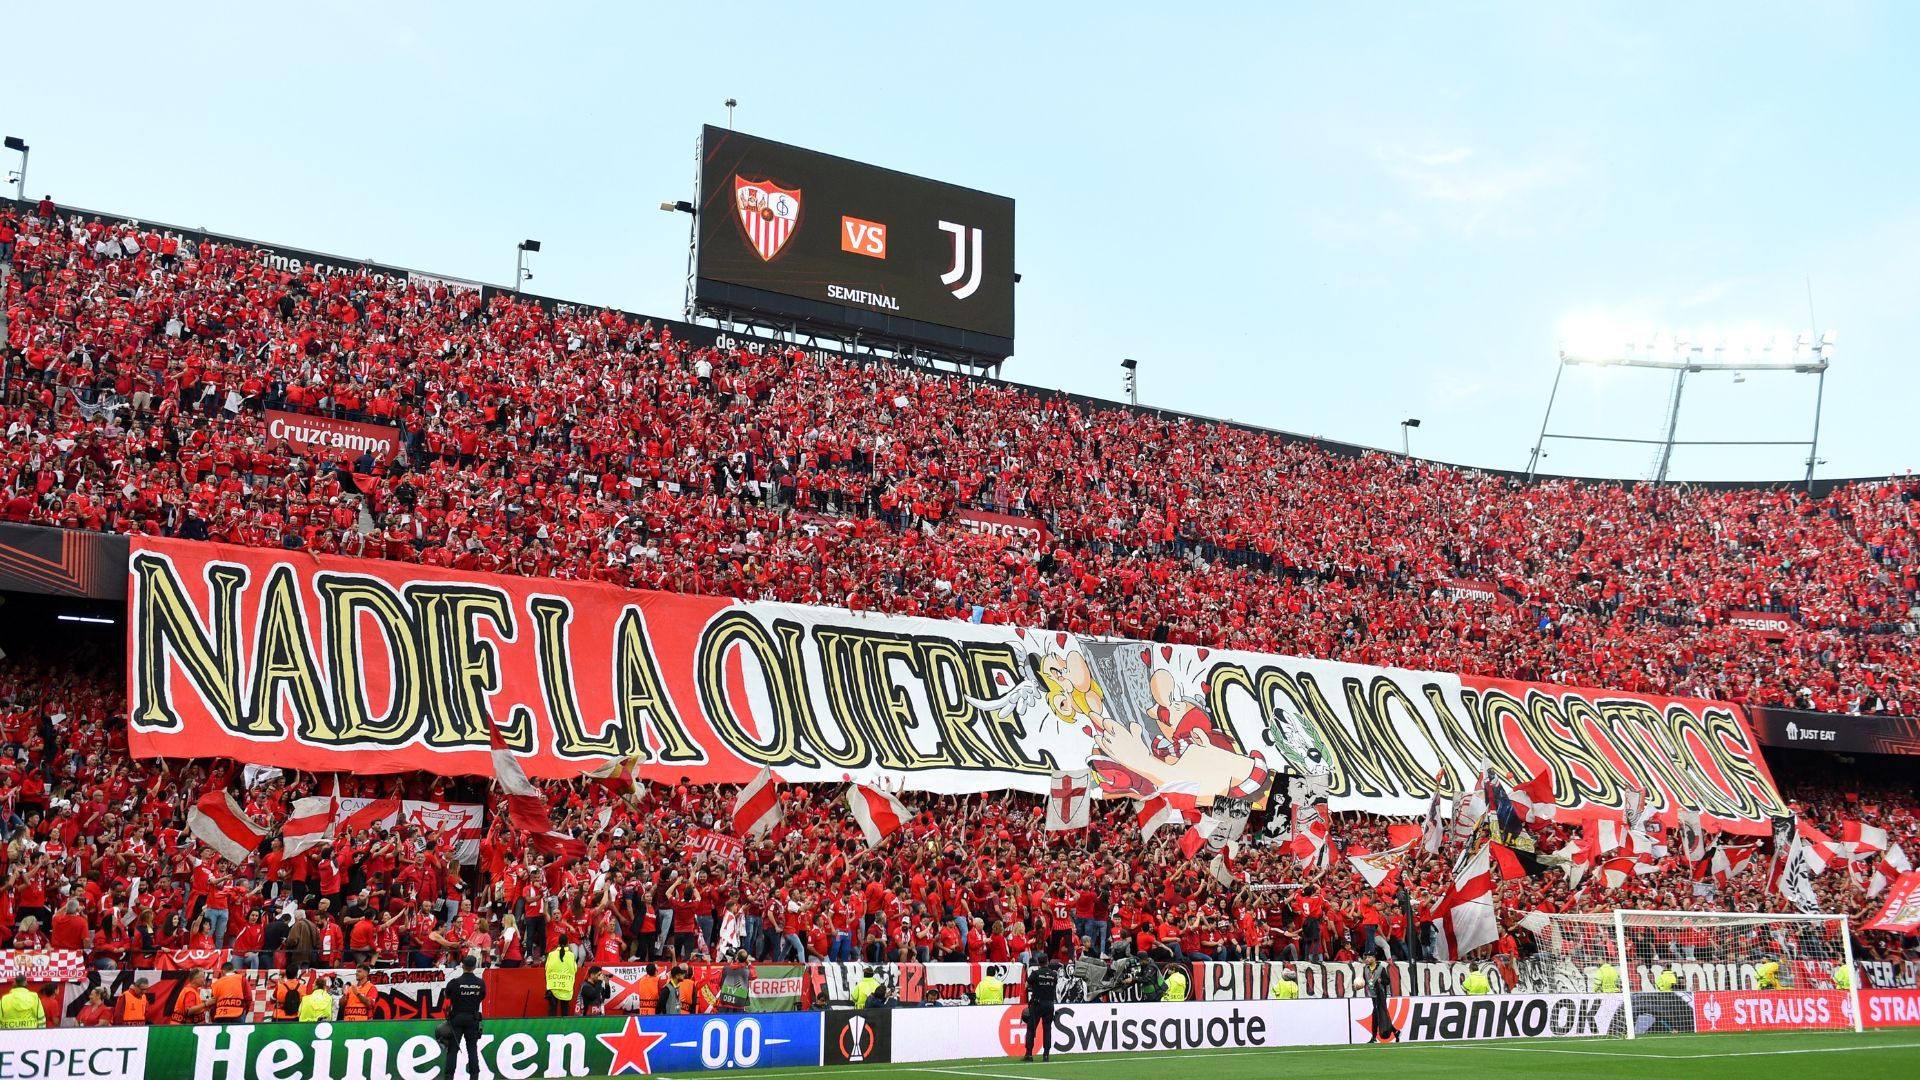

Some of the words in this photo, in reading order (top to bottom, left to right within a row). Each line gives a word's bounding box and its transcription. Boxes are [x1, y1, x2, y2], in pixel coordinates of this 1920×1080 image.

[845, 221, 884, 254] VS
[827, 284, 900, 311] SEMIFINAL
[715, 333, 735, 351] de
[270, 418, 391, 455] Cruzcampo
[980, 521, 1041, 542] DEGRO
[1738, 618, 1788, 632] DEGIRO
[133, 553, 534, 753] NADIE
[531, 597, 704, 763] LA
[1208, 664, 1464, 800] COMO
[1423, 684, 1793, 822] NOSOTROS
[1799, 728, 1819, 740] JUST
[1820, 730, 1837, 741] EAT
[1054, 906, 1068, 919] 16
[1302, 902, 1310, 915] 9
[391, 970, 446, 985] SEVILLISTA
[723, 994, 736, 1004] 091
[726, 986, 737, 994] TV
[1733, 996, 1830, 1025] STRAUSS
[1869, 995, 1920, 1022] STRA
[1053, 1007, 1266, 1052] Swissquote
[193, 1022, 590, 1080] Heineken
[701, 1017, 761, 1069] 0.0
